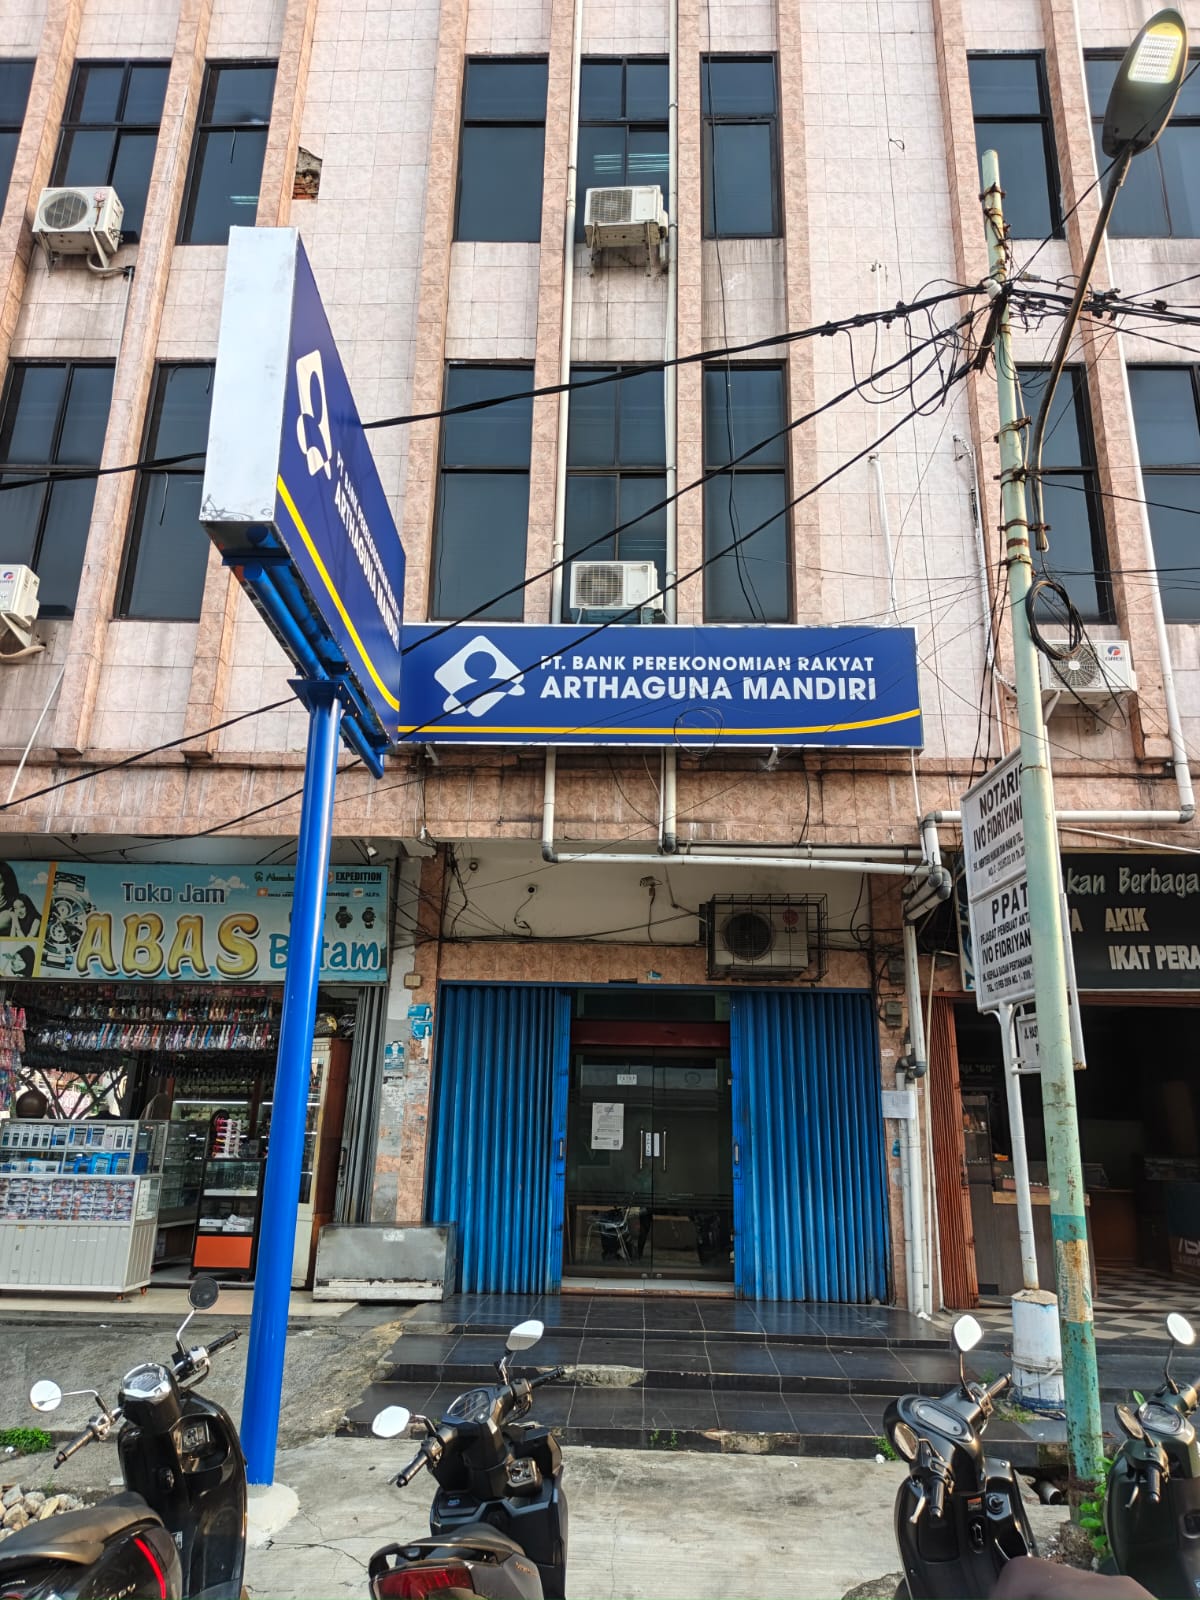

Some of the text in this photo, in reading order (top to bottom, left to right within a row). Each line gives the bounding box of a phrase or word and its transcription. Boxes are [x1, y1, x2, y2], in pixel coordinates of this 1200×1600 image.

[334, 480, 377, 599] ARTHAGUNA
[541, 655, 874, 672] PT. BANK PEREKONOMIAN RAKYAT
[540, 675, 876, 700] ARTHAGUNA MANDIRI
[973, 825, 986, 852] IVO
[336, 871, 382, 881] EXPEDITION
[1066, 867, 1200, 898] kan Berbaga
[121, 883, 226, 904] Toko Jam
[991, 881, 1028, 925] PPAT
[997, 917, 1018, 936] PEMBUAT
[1105, 907, 1149, 932] AKIK
[75, 911, 260, 978] ABAS
[269, 933, 380, 971] Btam
[994, 928, 1032, 960] FIDRIYAN
[1108, 945, 1151, 970] IKAT
